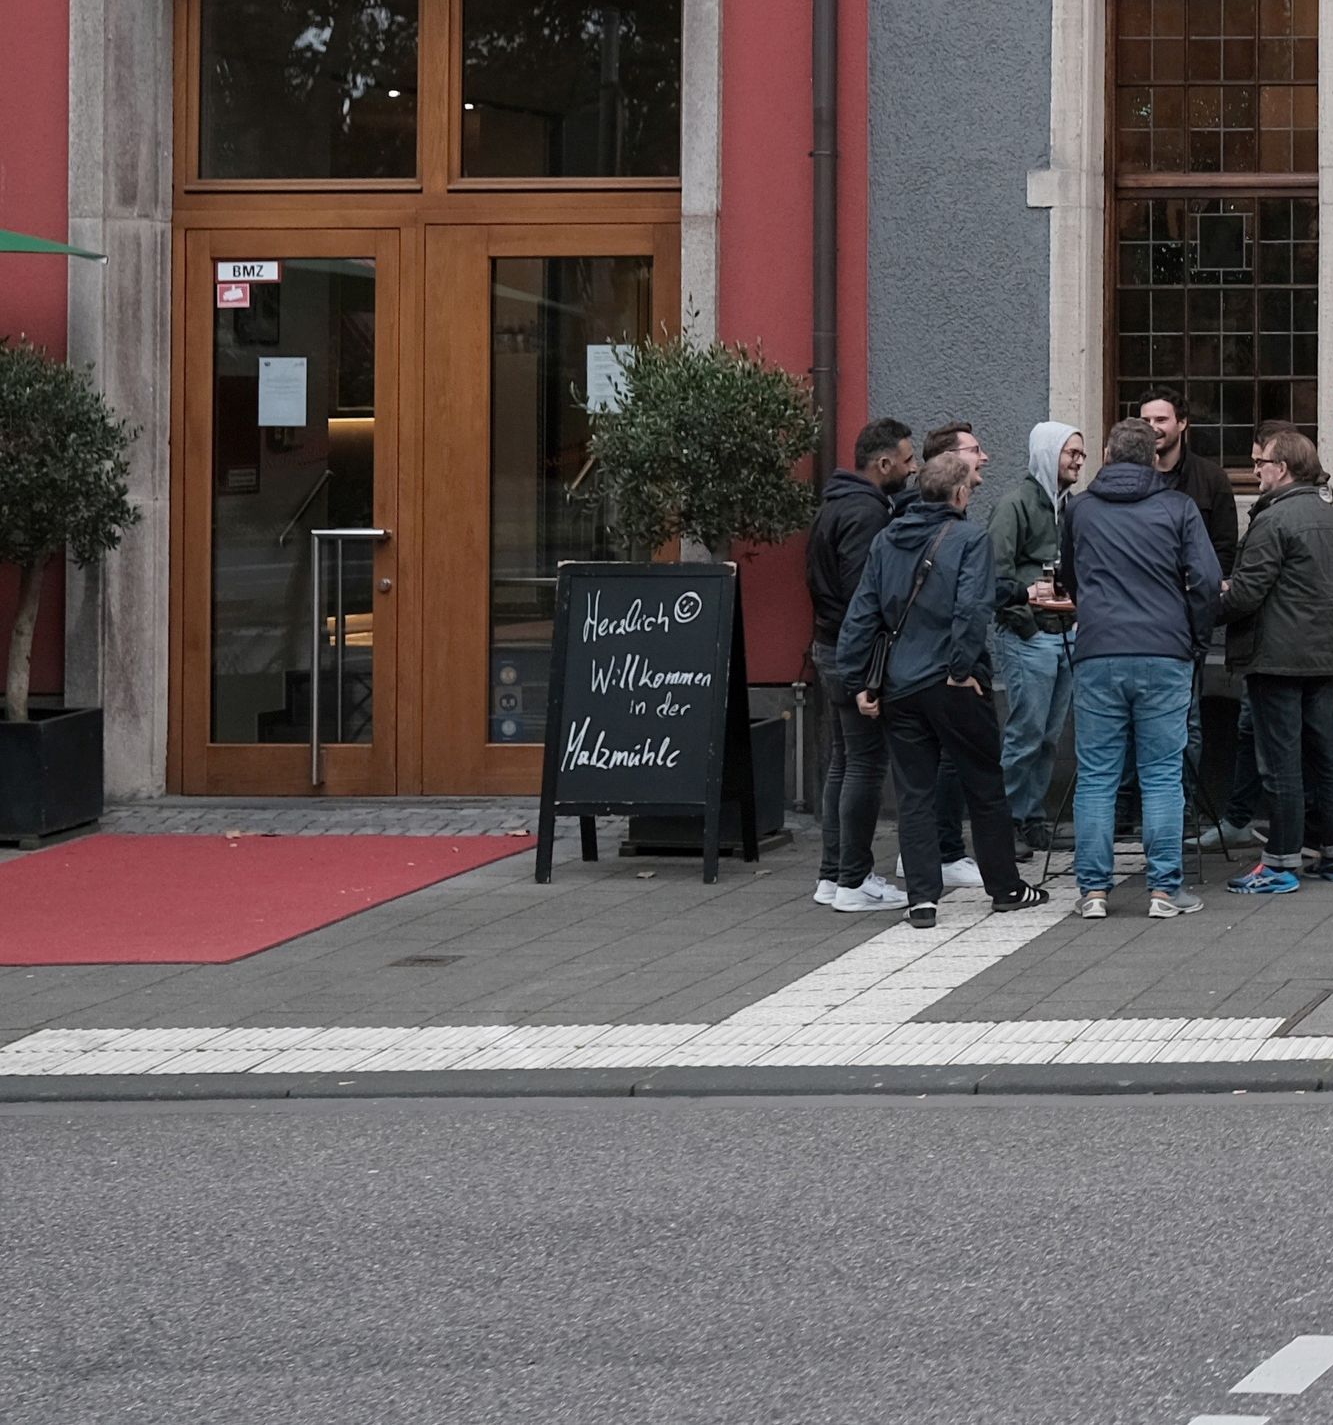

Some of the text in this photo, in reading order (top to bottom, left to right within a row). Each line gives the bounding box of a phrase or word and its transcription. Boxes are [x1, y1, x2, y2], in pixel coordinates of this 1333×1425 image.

[232, 264, 264, 278] BMZ
[583, 590, 669, 642] Herzlich
[591, 653, 712, 695] Willkommen
[629, 691, 691, 718] in der
